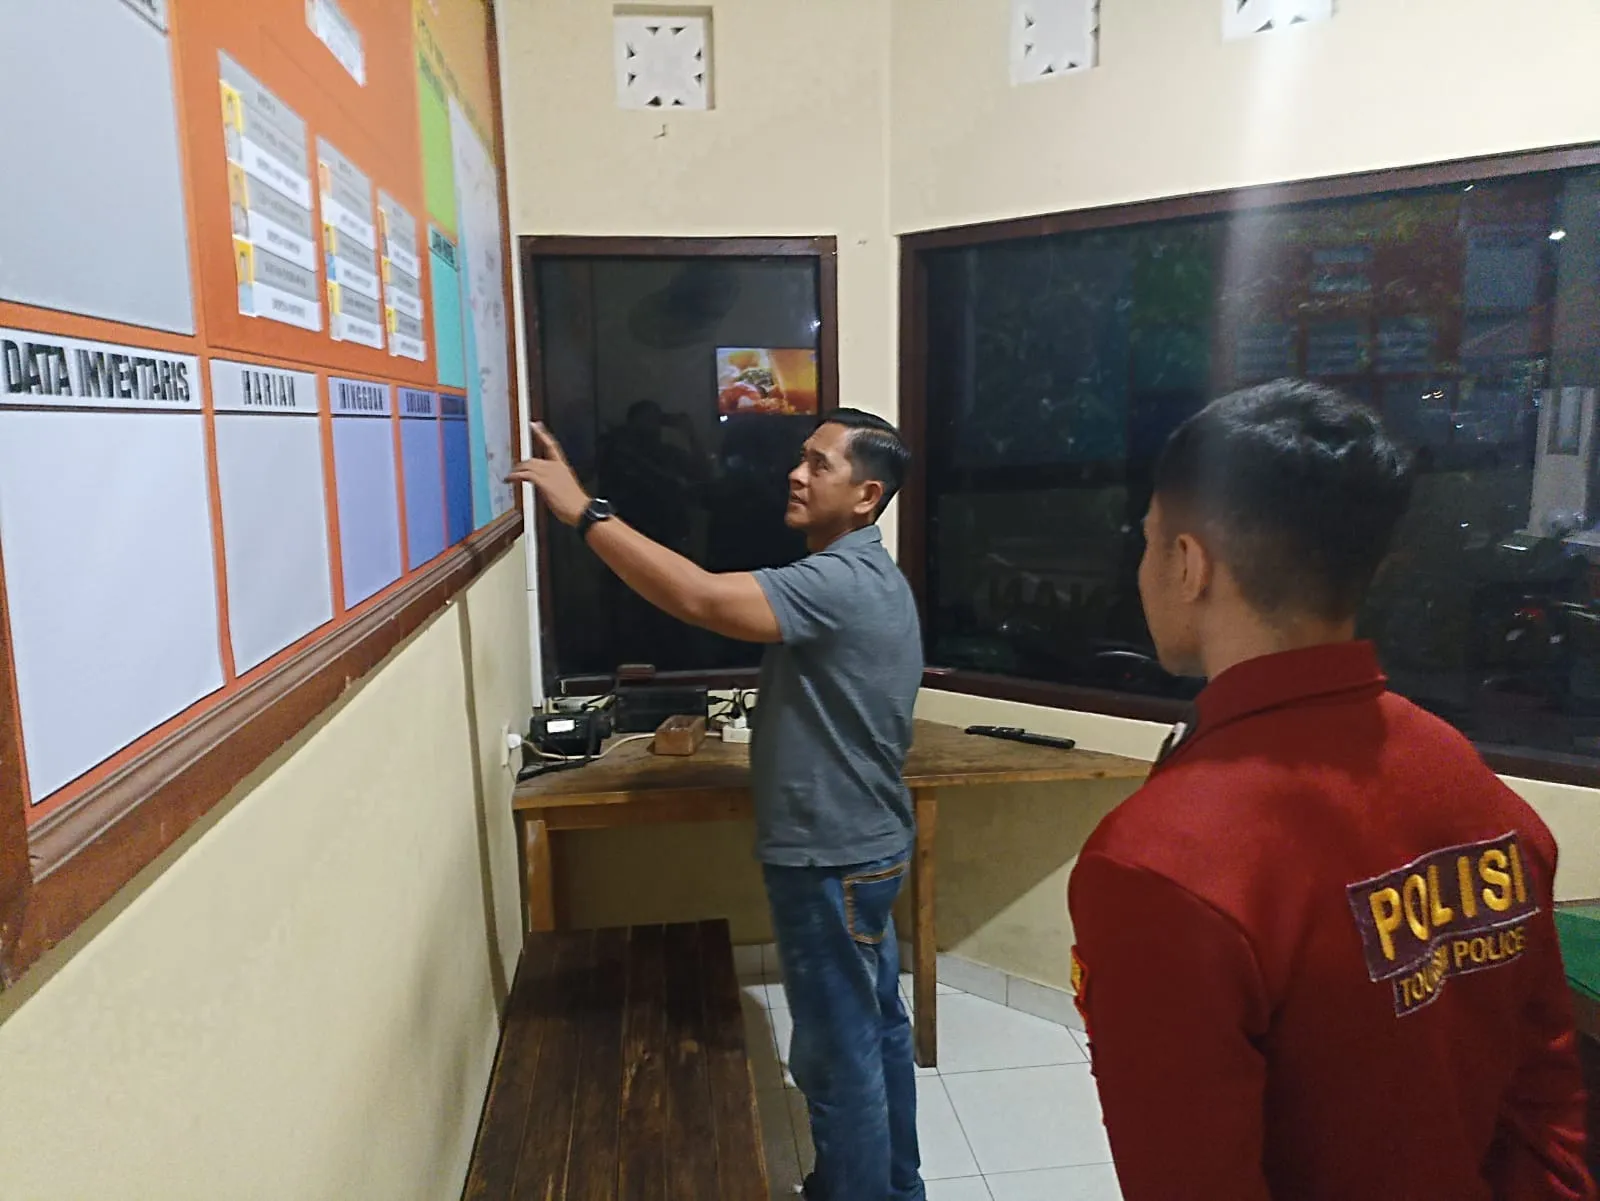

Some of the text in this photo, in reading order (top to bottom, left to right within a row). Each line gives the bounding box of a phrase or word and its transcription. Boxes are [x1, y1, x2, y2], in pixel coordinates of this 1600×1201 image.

[1, 339, 190, 402] DATA INVENTARIS
[240, 370, 296, 406] HARIAN
[1369, 844, 1526, 961] POLISI
[1453, 927, 1524, 968] POLICE
